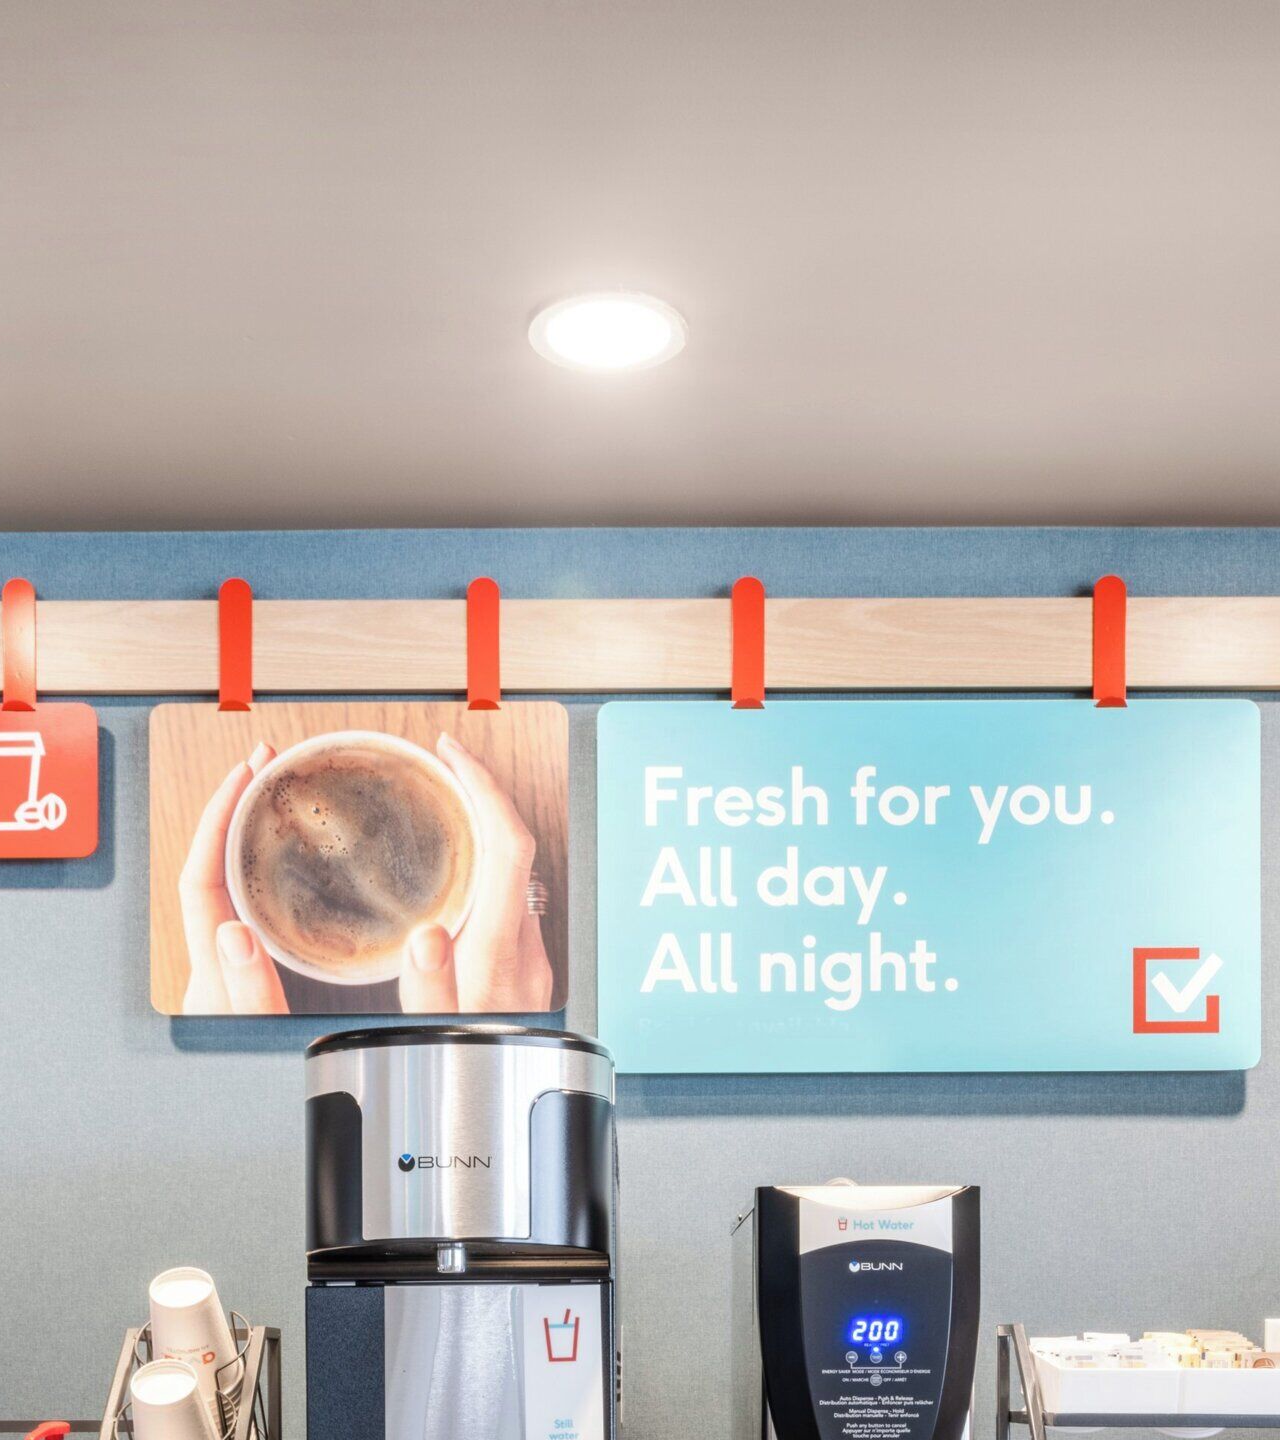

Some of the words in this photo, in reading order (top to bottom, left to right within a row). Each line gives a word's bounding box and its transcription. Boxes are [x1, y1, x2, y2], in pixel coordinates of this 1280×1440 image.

[643, 766, 829, 826] Fresh
[851, 766, 950, 826] for
[969, 783, 1115, 844] you.
[640, 846, 738, 907] All
[756, 846, 908, 925] day.
[640, 932, 738, 993] All
[759, 932, 959, 1012] night.
[417, 1155, 491, 1168] BUNN
[853, 1219, 874, 1230] Hot
[878, 1219, 914, 1230] Water
[861, 1262, 903, 1271] BUNN
[852, 1320, 899, 1341] 200
[554, 1418, 574, 1429] Still
[549, 1432, 579, 1440] water
